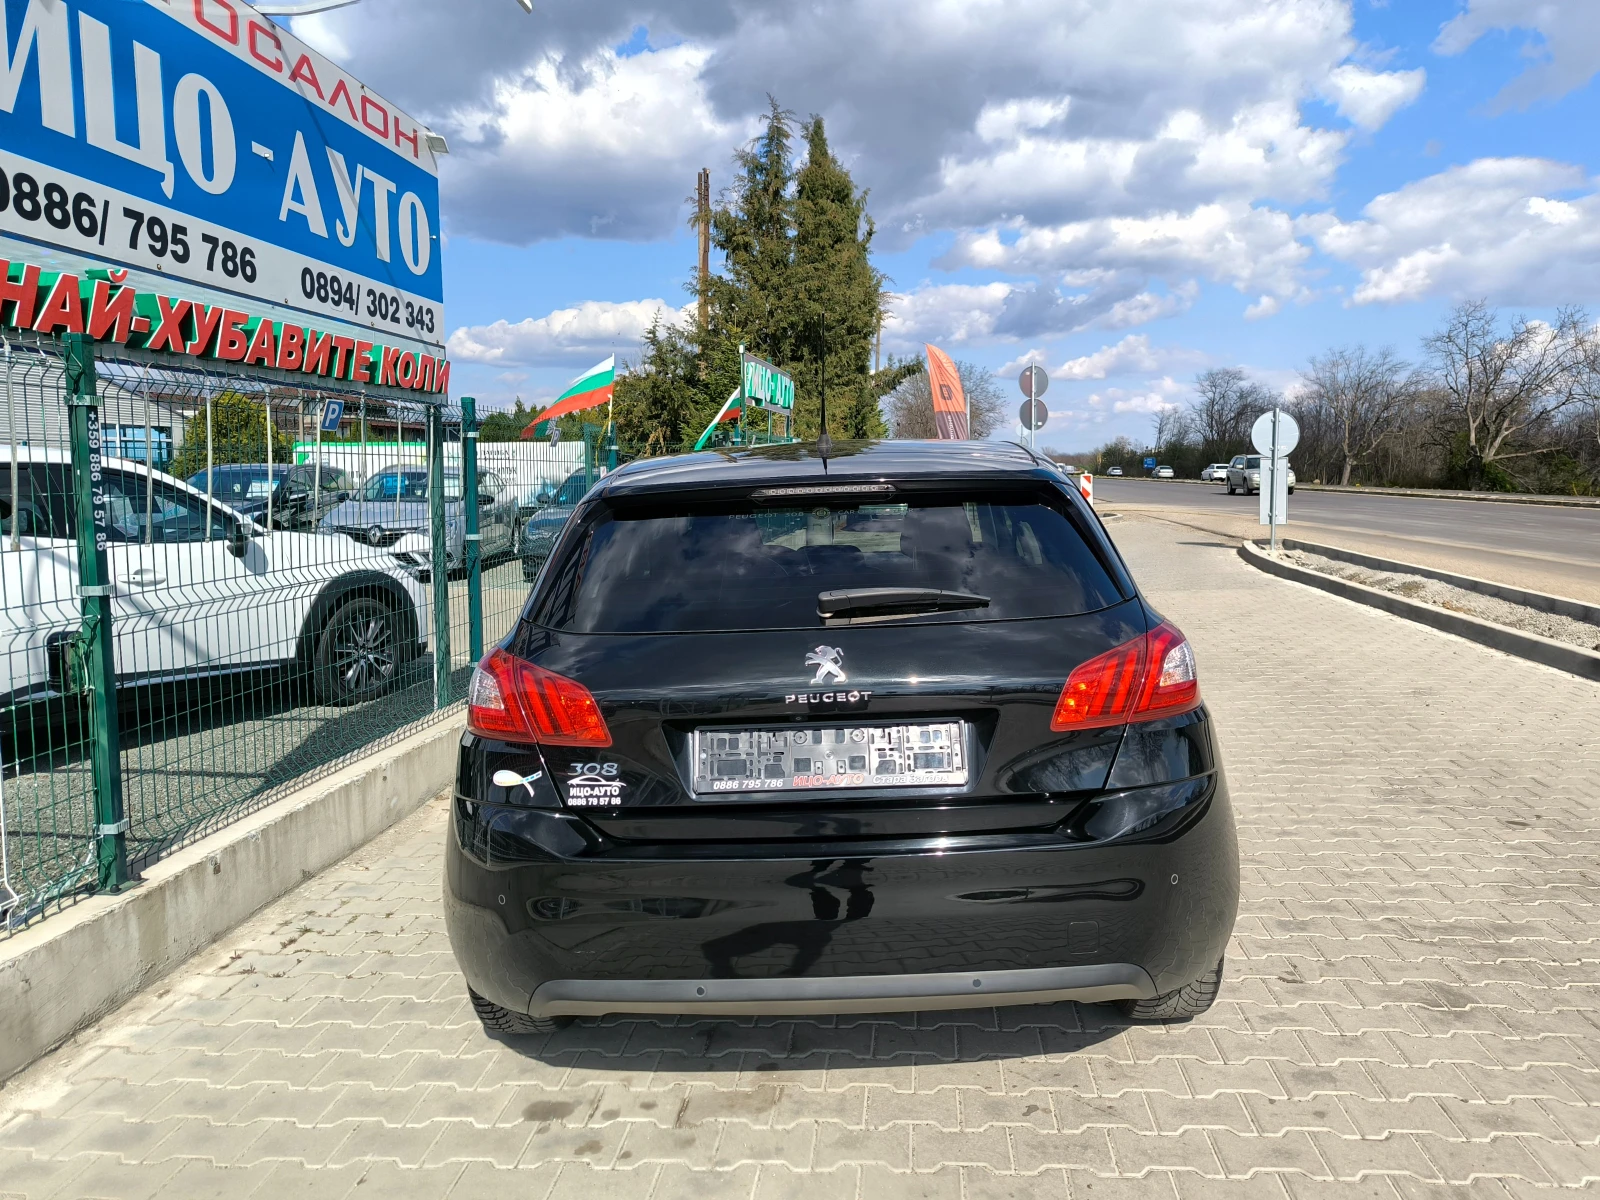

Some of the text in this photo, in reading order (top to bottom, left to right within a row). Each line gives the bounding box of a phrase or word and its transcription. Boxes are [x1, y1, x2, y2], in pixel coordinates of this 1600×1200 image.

[165, 0, 419, 159] ОСАЛОН
[123, 206, 190, 264] 795
[201, 233, 257, 283] 786
[300, 266, 361, 316] 0894/
[366, 289, 400, 324] 302
[405, 300, 435, 333] 343
[0, 257, 450, 395] НАЙ-ХУБАВИТЕ КОЛИ
[325, 403, 338, 427] P
[87, 411, 107, 551] +359 886 79 57 86
[784, 691, 872, 704] PEUGEOT
[567, 762, 618, 776] 308
[713, 778, 784, 790] 0886 795 786
[792, 773, 865, 787] ИЦО-АУТО
[872, 773, 907, 785] Стара
[569, 786, 620, 797] ИЦО-АУТО
[567, 798, 586, 806] 0886
[599, 797, 609, 805] 57
